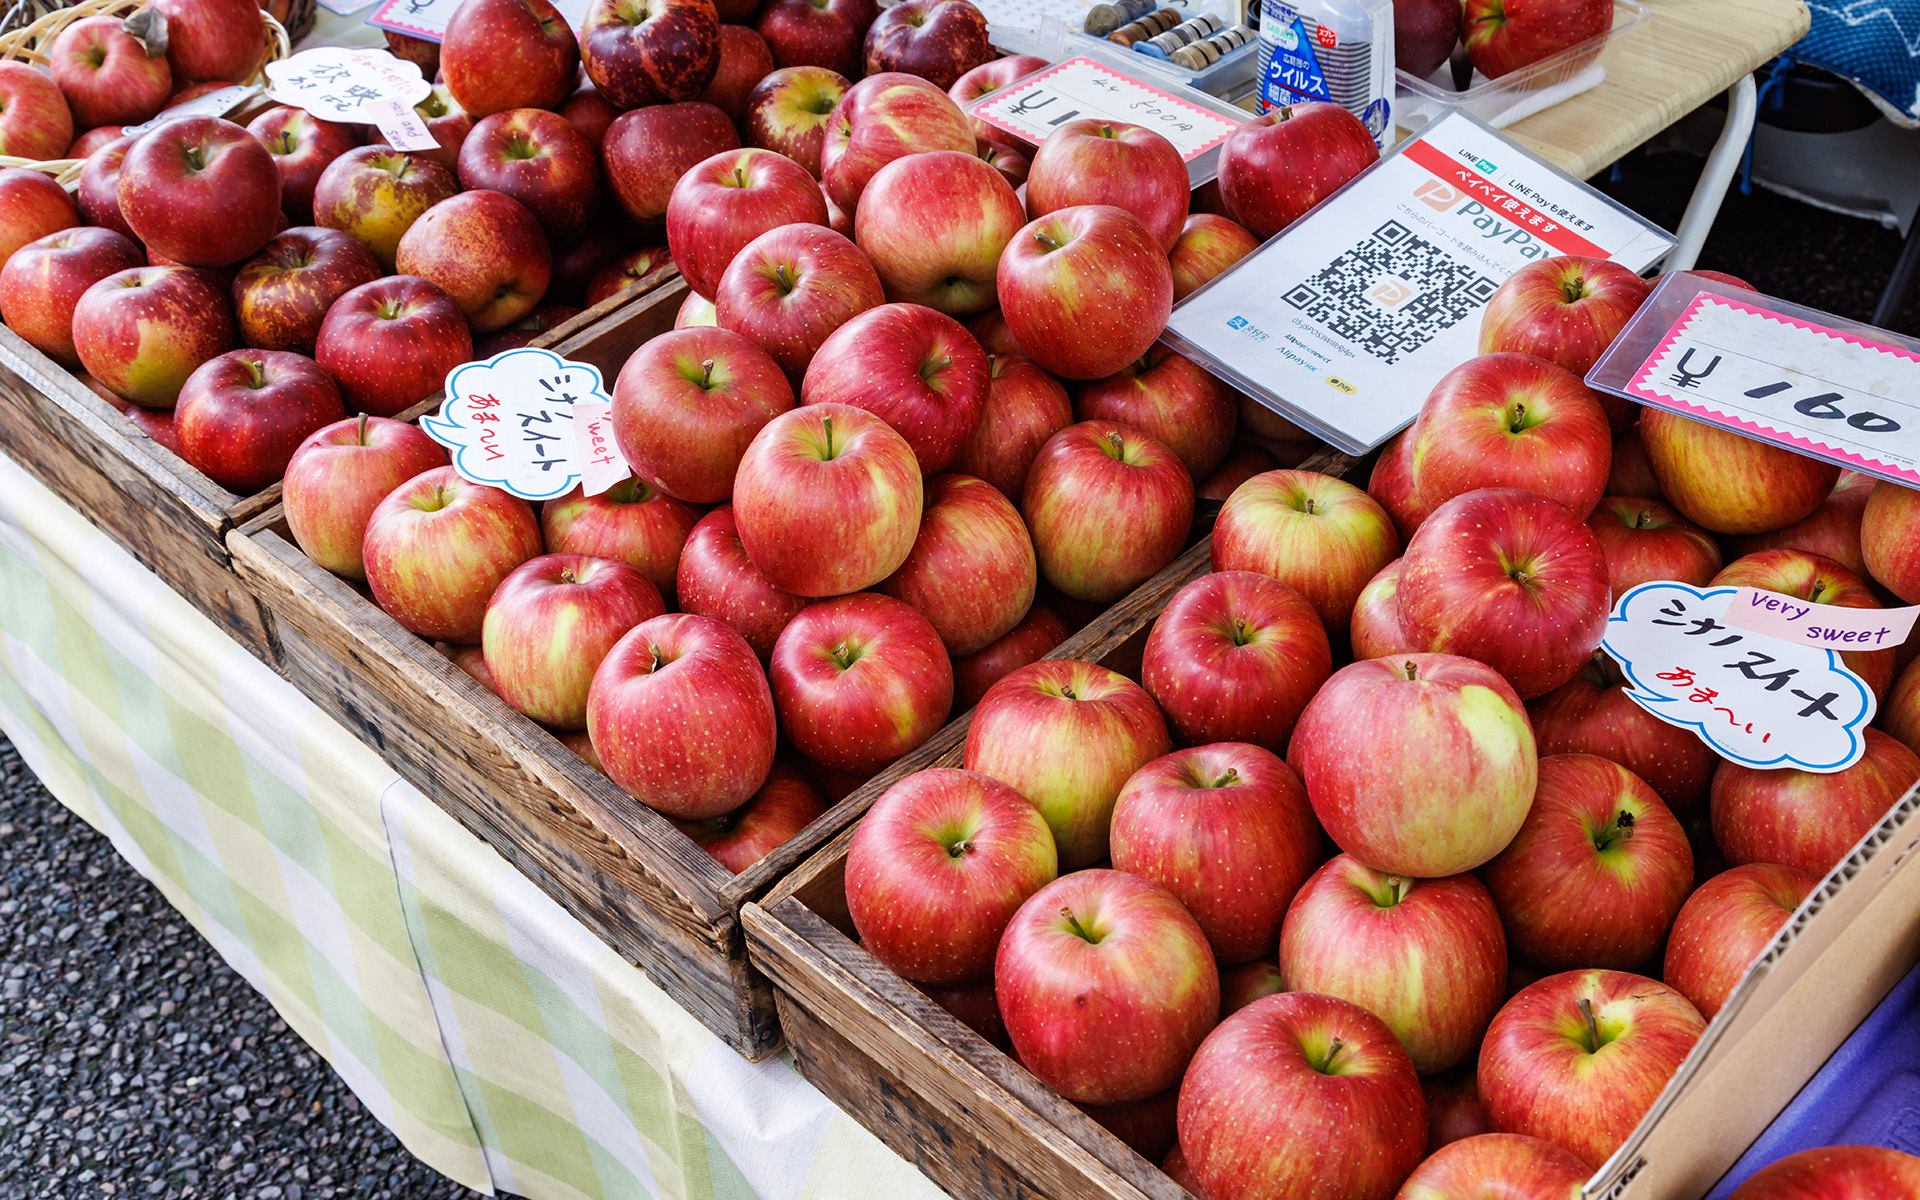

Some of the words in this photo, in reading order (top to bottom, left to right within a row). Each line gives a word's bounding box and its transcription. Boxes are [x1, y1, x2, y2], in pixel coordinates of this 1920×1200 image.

[1266, 21, 1295, 42] SARAYA
[1270, 60, 1325, 96] ウイルス
[1009, 89, 1058, 115] ¥
[1458, 149, 1479, 163] LINE
[1478, 160, 1494, 173] Pay
[1508, 179, 1533, 196] LINE
[1456, 170, 1558, 232] ペイペイ使えます
[1336, 382, 1353, 392] pay
[1669, 347, 1723, 389] ¥
[1743, 381, 1901, 433] 160
[586, 417, 616, 465] weet
[1806, 626, 1891, 644] sweet
